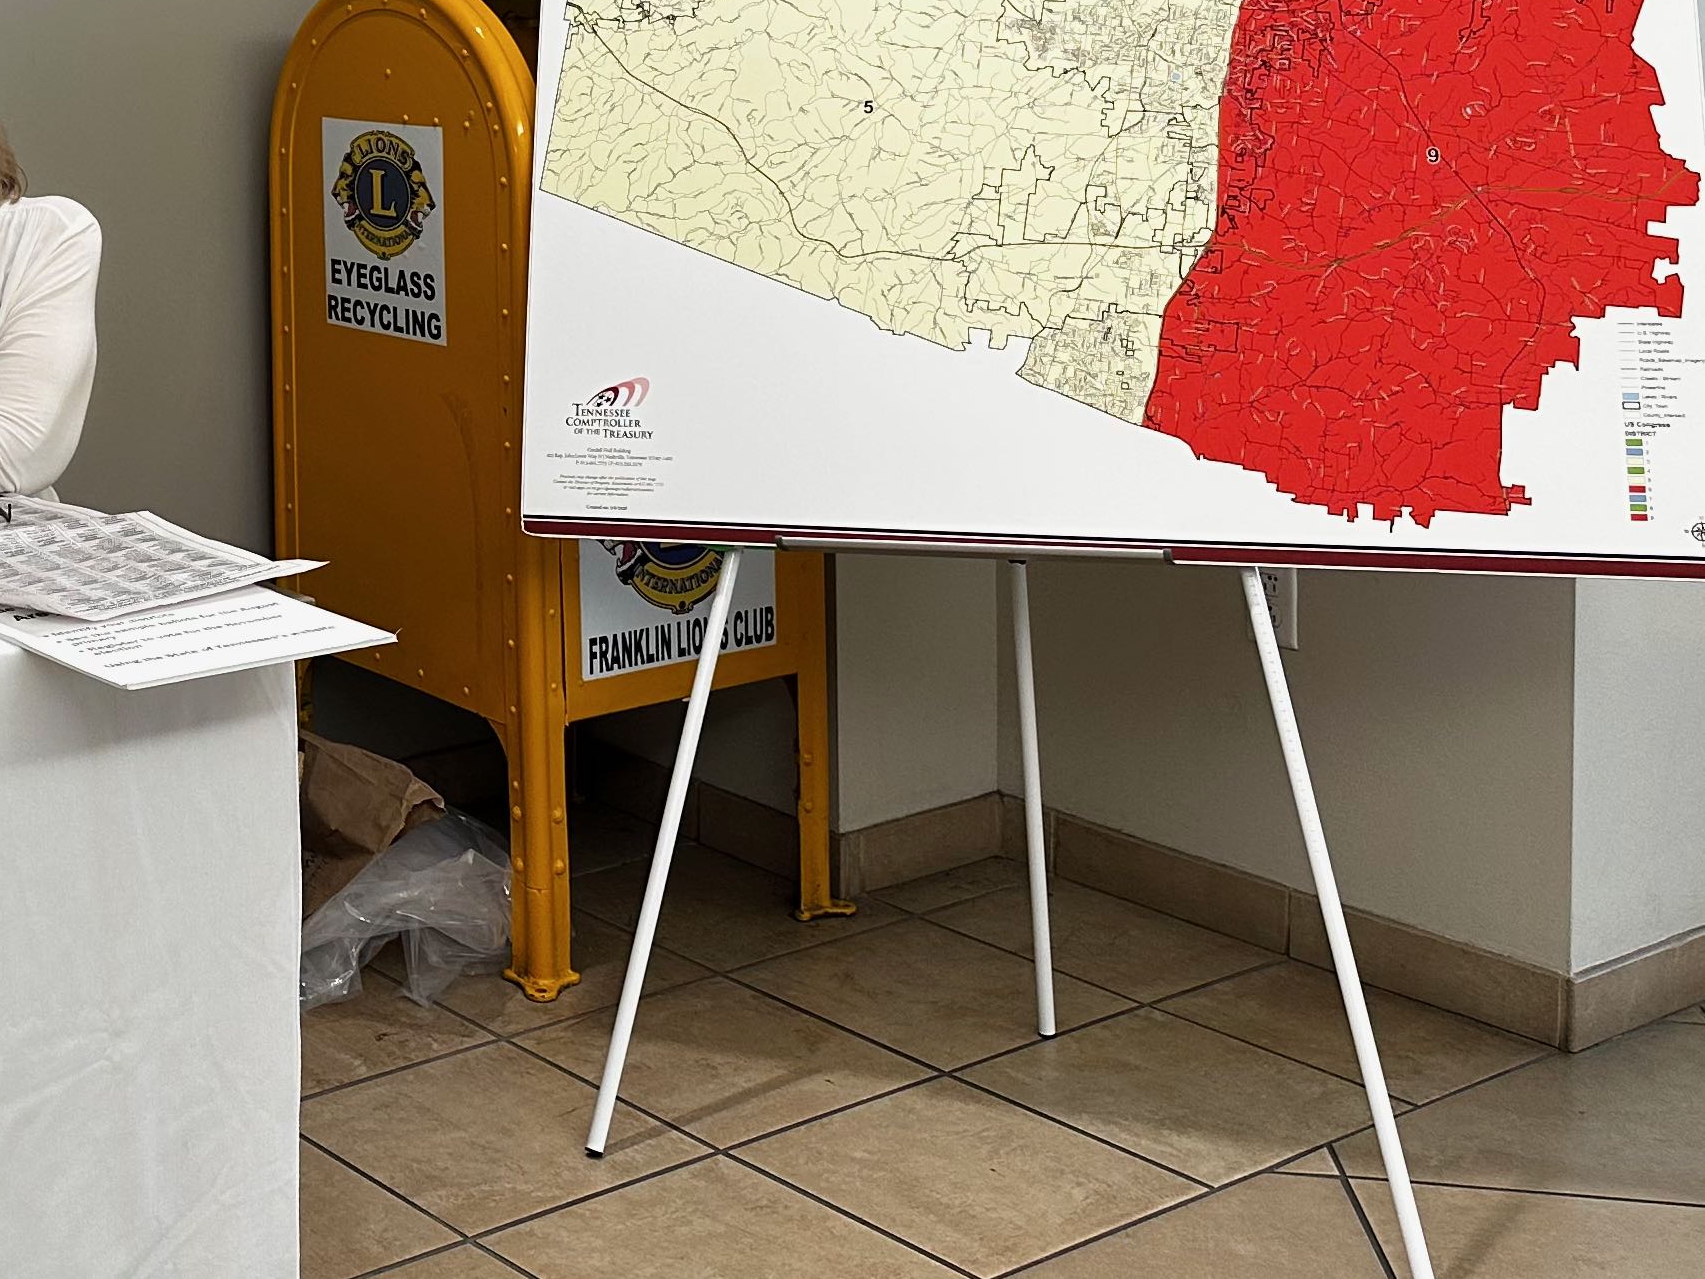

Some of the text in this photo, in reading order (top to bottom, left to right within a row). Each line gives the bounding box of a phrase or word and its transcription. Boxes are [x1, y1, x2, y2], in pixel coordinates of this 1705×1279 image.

[863, 100, 874, 114] 5
[358, 137, 412, 166] LIONS
[1427, 147, 1439, 163] 9
[369, 169, 397, 218] L
[330, 258, 436, 302] EYEGLASS
[327, 294, 442, 340] RECYCLING
[572, 403, 631, 418] TENNESSEE
[566, 417, 641, 428] COMPTROLLER
[603, 429, 654, 439] TREASURY
[588, 624, 672, 675] FRANKLIN
[733, 606, 775, 647] CLUB
